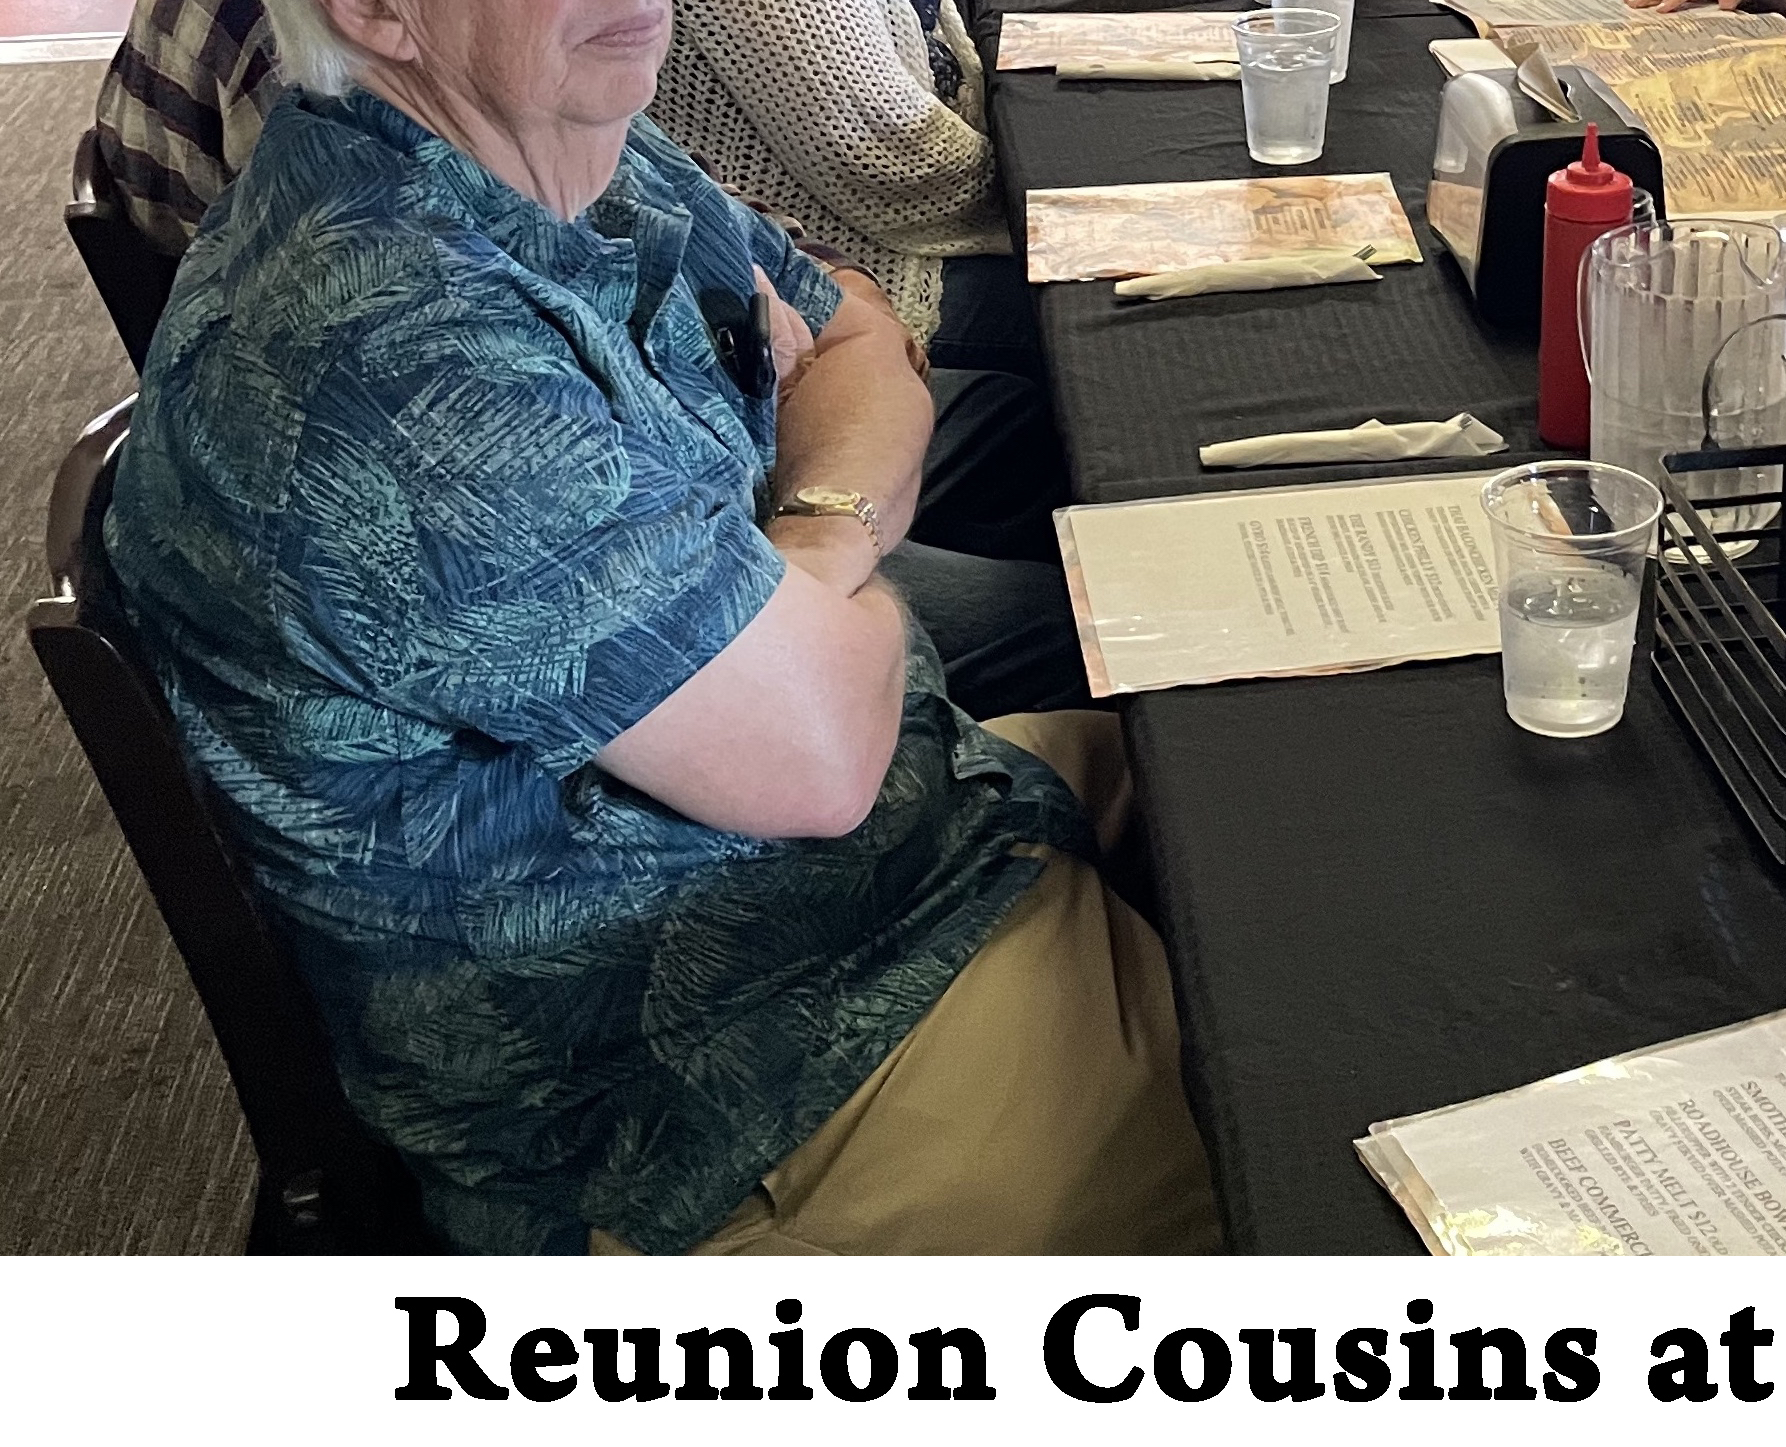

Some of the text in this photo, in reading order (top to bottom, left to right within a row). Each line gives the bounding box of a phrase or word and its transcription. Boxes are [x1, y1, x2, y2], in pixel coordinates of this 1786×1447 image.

[1548, 1138, 1656, 1256] BEEF COMMERCI
[1613, 1120, 1664, 1164] PATTY
[1651, 1168, 1698, 1208] MELT
[1688, 1211, 1718, 1237] $12
[1678, 1099, 1763, 1190] ROADHOUSE
